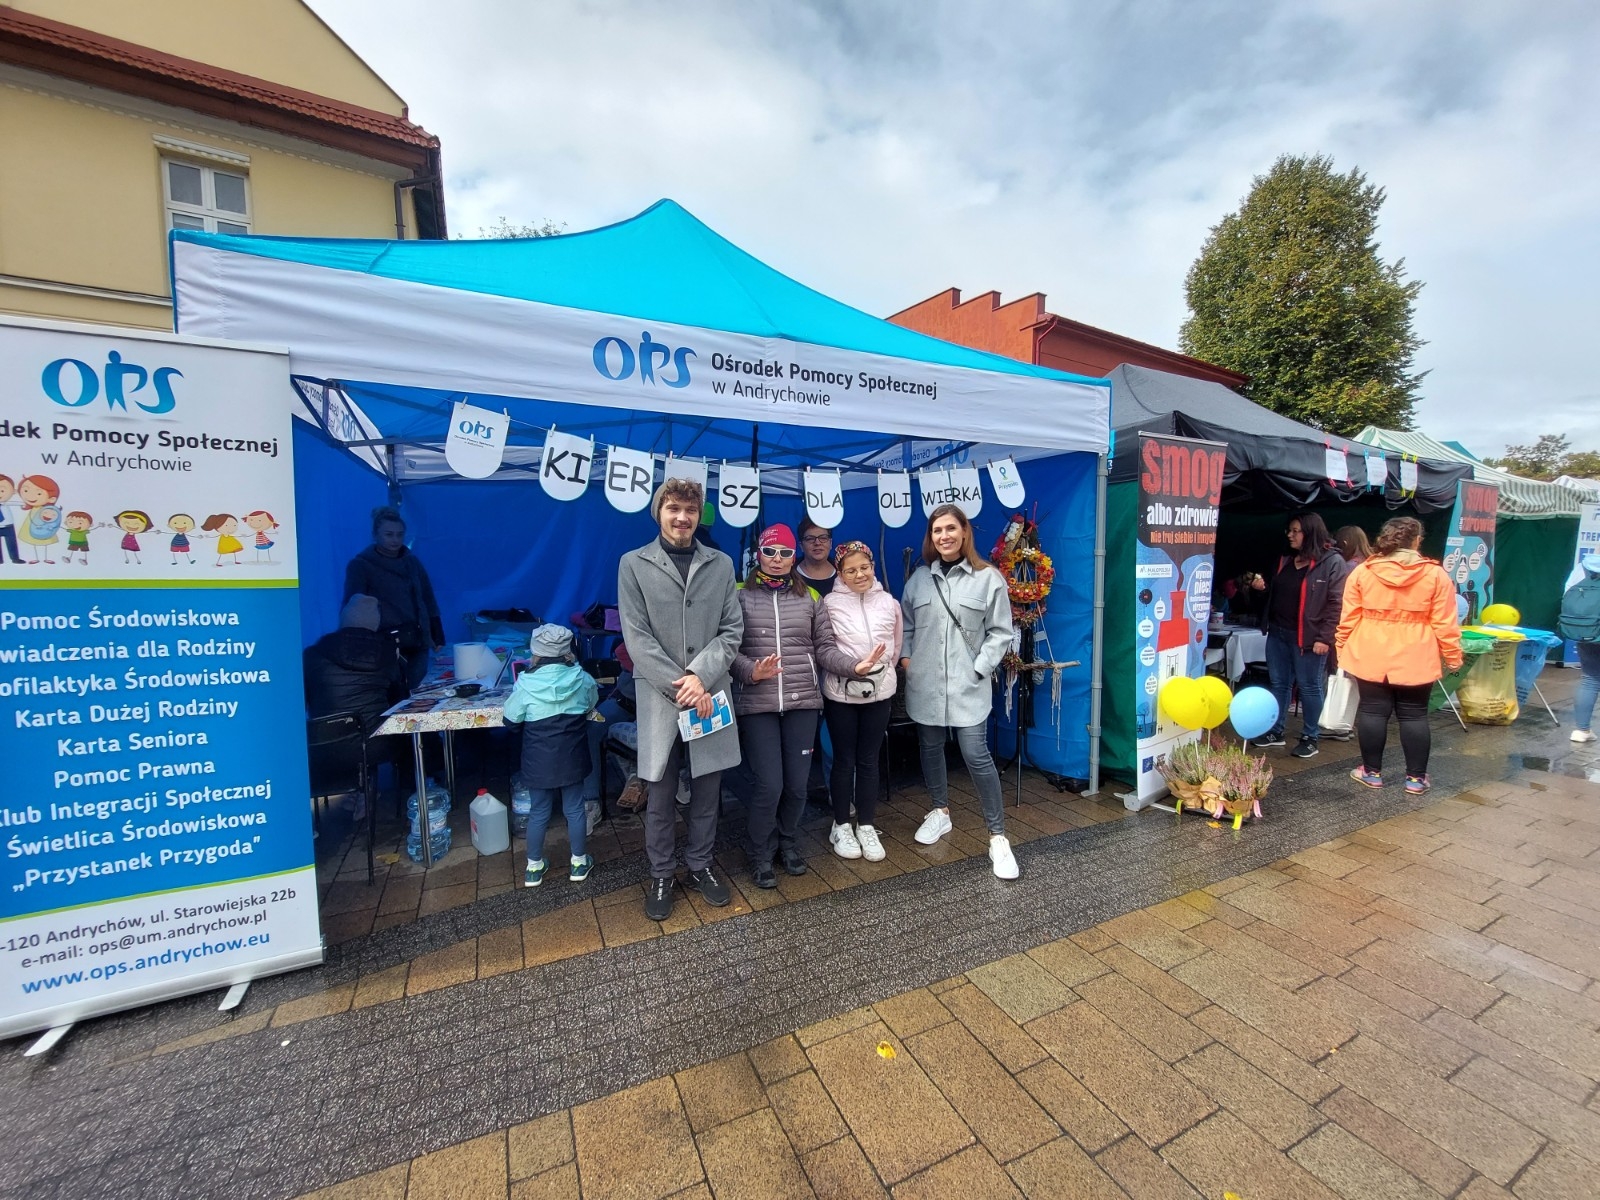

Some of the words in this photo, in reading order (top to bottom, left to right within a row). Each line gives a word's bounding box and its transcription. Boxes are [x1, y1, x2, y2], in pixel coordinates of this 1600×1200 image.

[592, 331, 698, 389] OPS
[41, 350, 185, 414] OPS
[711, 352, 785, 381] Ośrodek
[790, 362, 853, 389] Pomocy
[858, 371, 938, 401] Społecznej
[712, 381, 727, 395] w
[733, 379, 831, 407] Andrychowie
[53, 423, 150, 449] Pomocy
[158, 431, 278, 457] Społecznej
[41, 453, 58, 465] w
[67, 450, 192, 472] Andrychowie
[720, 484, 759, 509] SZ
[807, 491, 843, 508] DLA
[1146, 503, 1172, 525] albo
[1151, 531, 1162, 543] Nie
[1162, 531, 1174, 544] truj
[1175, 531, 1194, 544] siebie
[1, 612, 81, 631] Pomoc
[88, 606, 240, 629] Środowiskowa
[137, 640, 170, 659] dla
[177, 638, 256, 659] Rodziny
[125, 667, 271, 690] Środowiskowa
[16, 709, 82, 728] Karta
[90, 702, 151, 723] Dużej
[158, 699, 238, 719] Rodziny
[57, 737, 121, 757] Karta
[128, 730, 208, 751] Seniora
[54, 766, 131, 789] Pomoc
[139, 760, 216, 780] Prawna
[50, 792, 158, 820] Integracji
[165, 779, 272, 809] Społecznej
[7, 828, 115, 859] Świetlica
[121, 812, 267, 841] Środowiskowa
[45, 915, 146, 945] Andrychów,
[150, 910, 170, 925] ul.
[173, 893, 267, 921] Starowiejska
[270, 887, 296, 903] 22b
[21, 948, 84, 969] e-mail:
[88, 909, 267, 960] ops@um.andrychow.pl
[22, 931, 270, 994] www.ops.andrychow.eu
